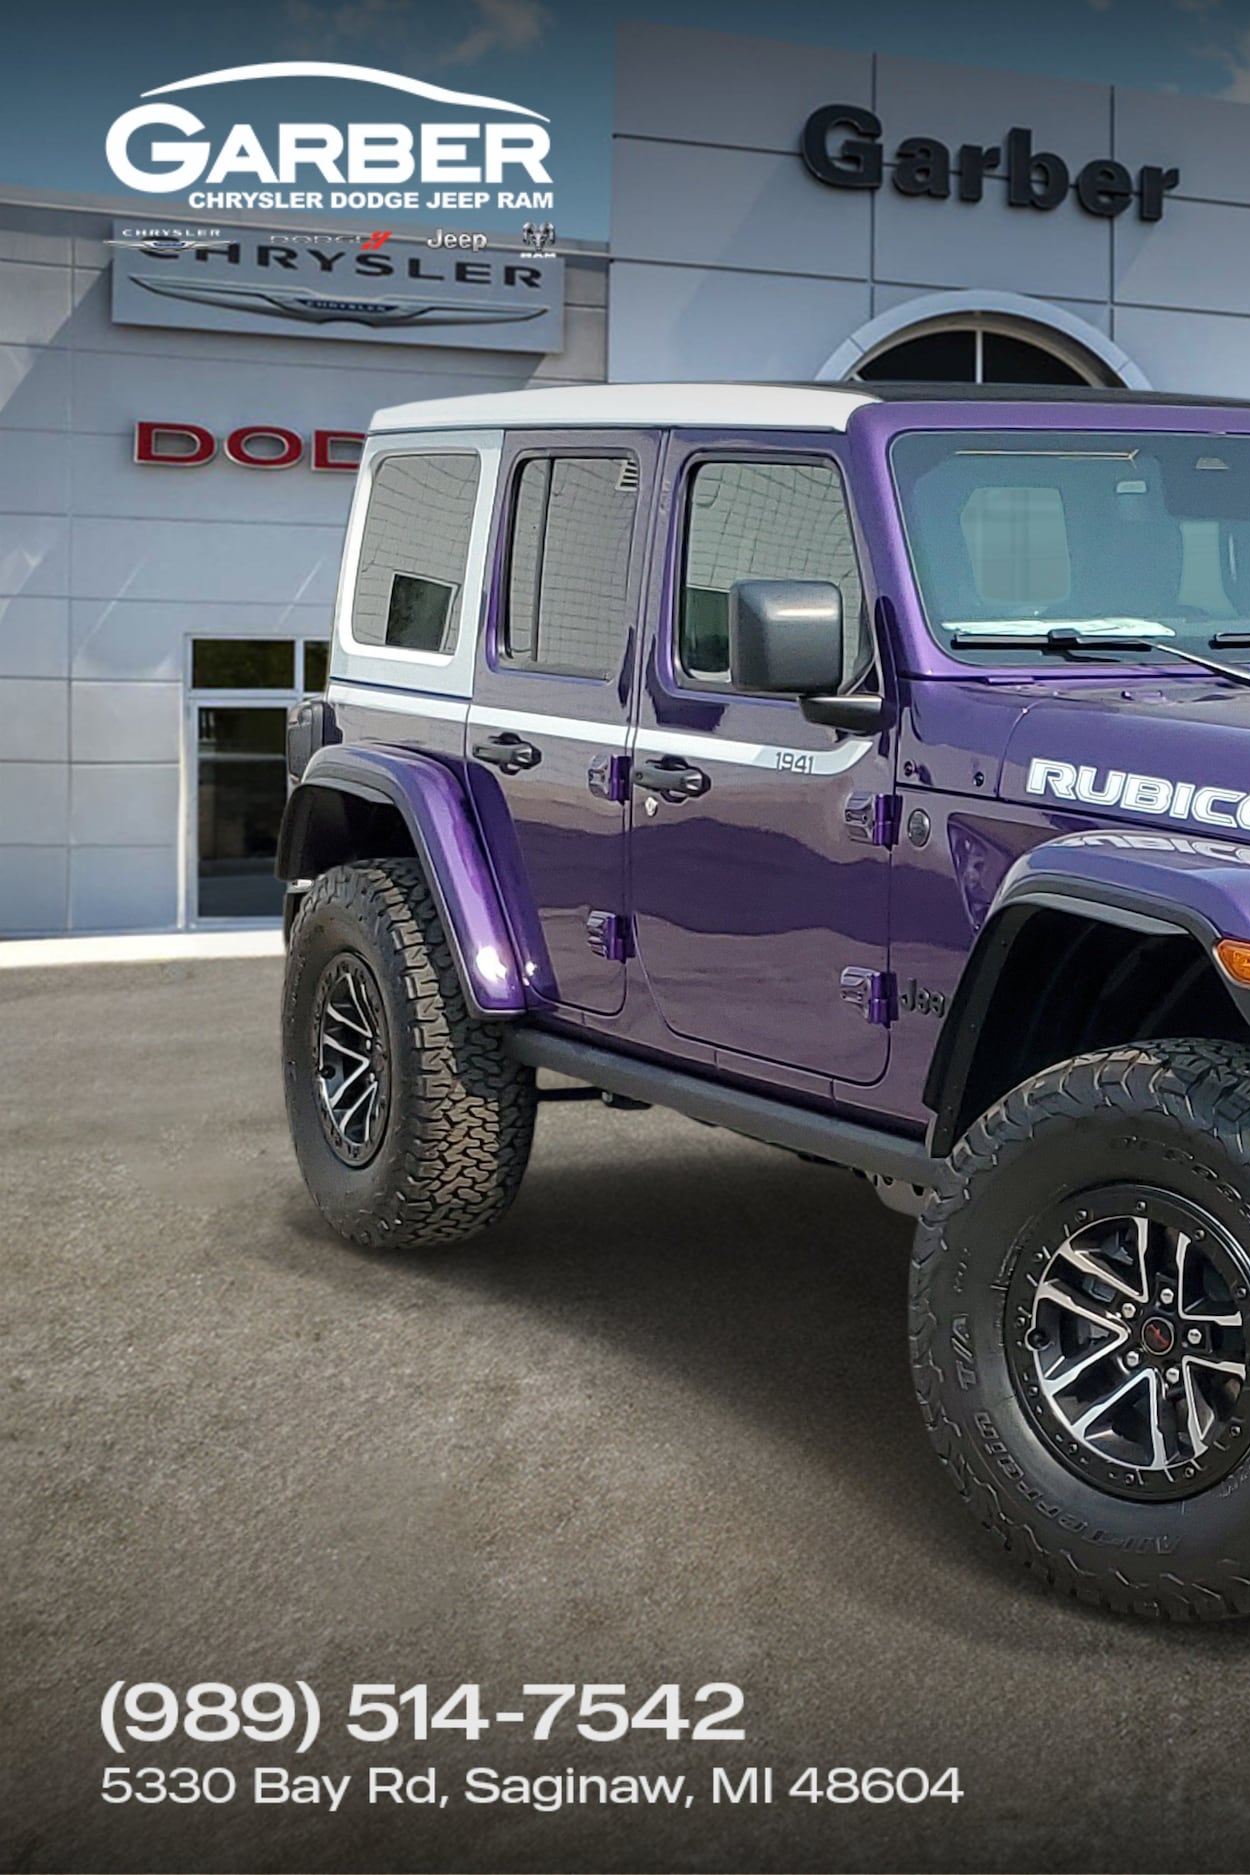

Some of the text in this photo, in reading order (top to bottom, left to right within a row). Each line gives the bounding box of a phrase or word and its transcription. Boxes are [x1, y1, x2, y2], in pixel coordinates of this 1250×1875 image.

[801, 104, 1180, 222] Garber
[139, 236, 543, 288] CHRYSLER
[133, 421, 366, 472] DOD
[775, 751, 815, 774] 1941
[900, 978, 946, 1018] Jee
